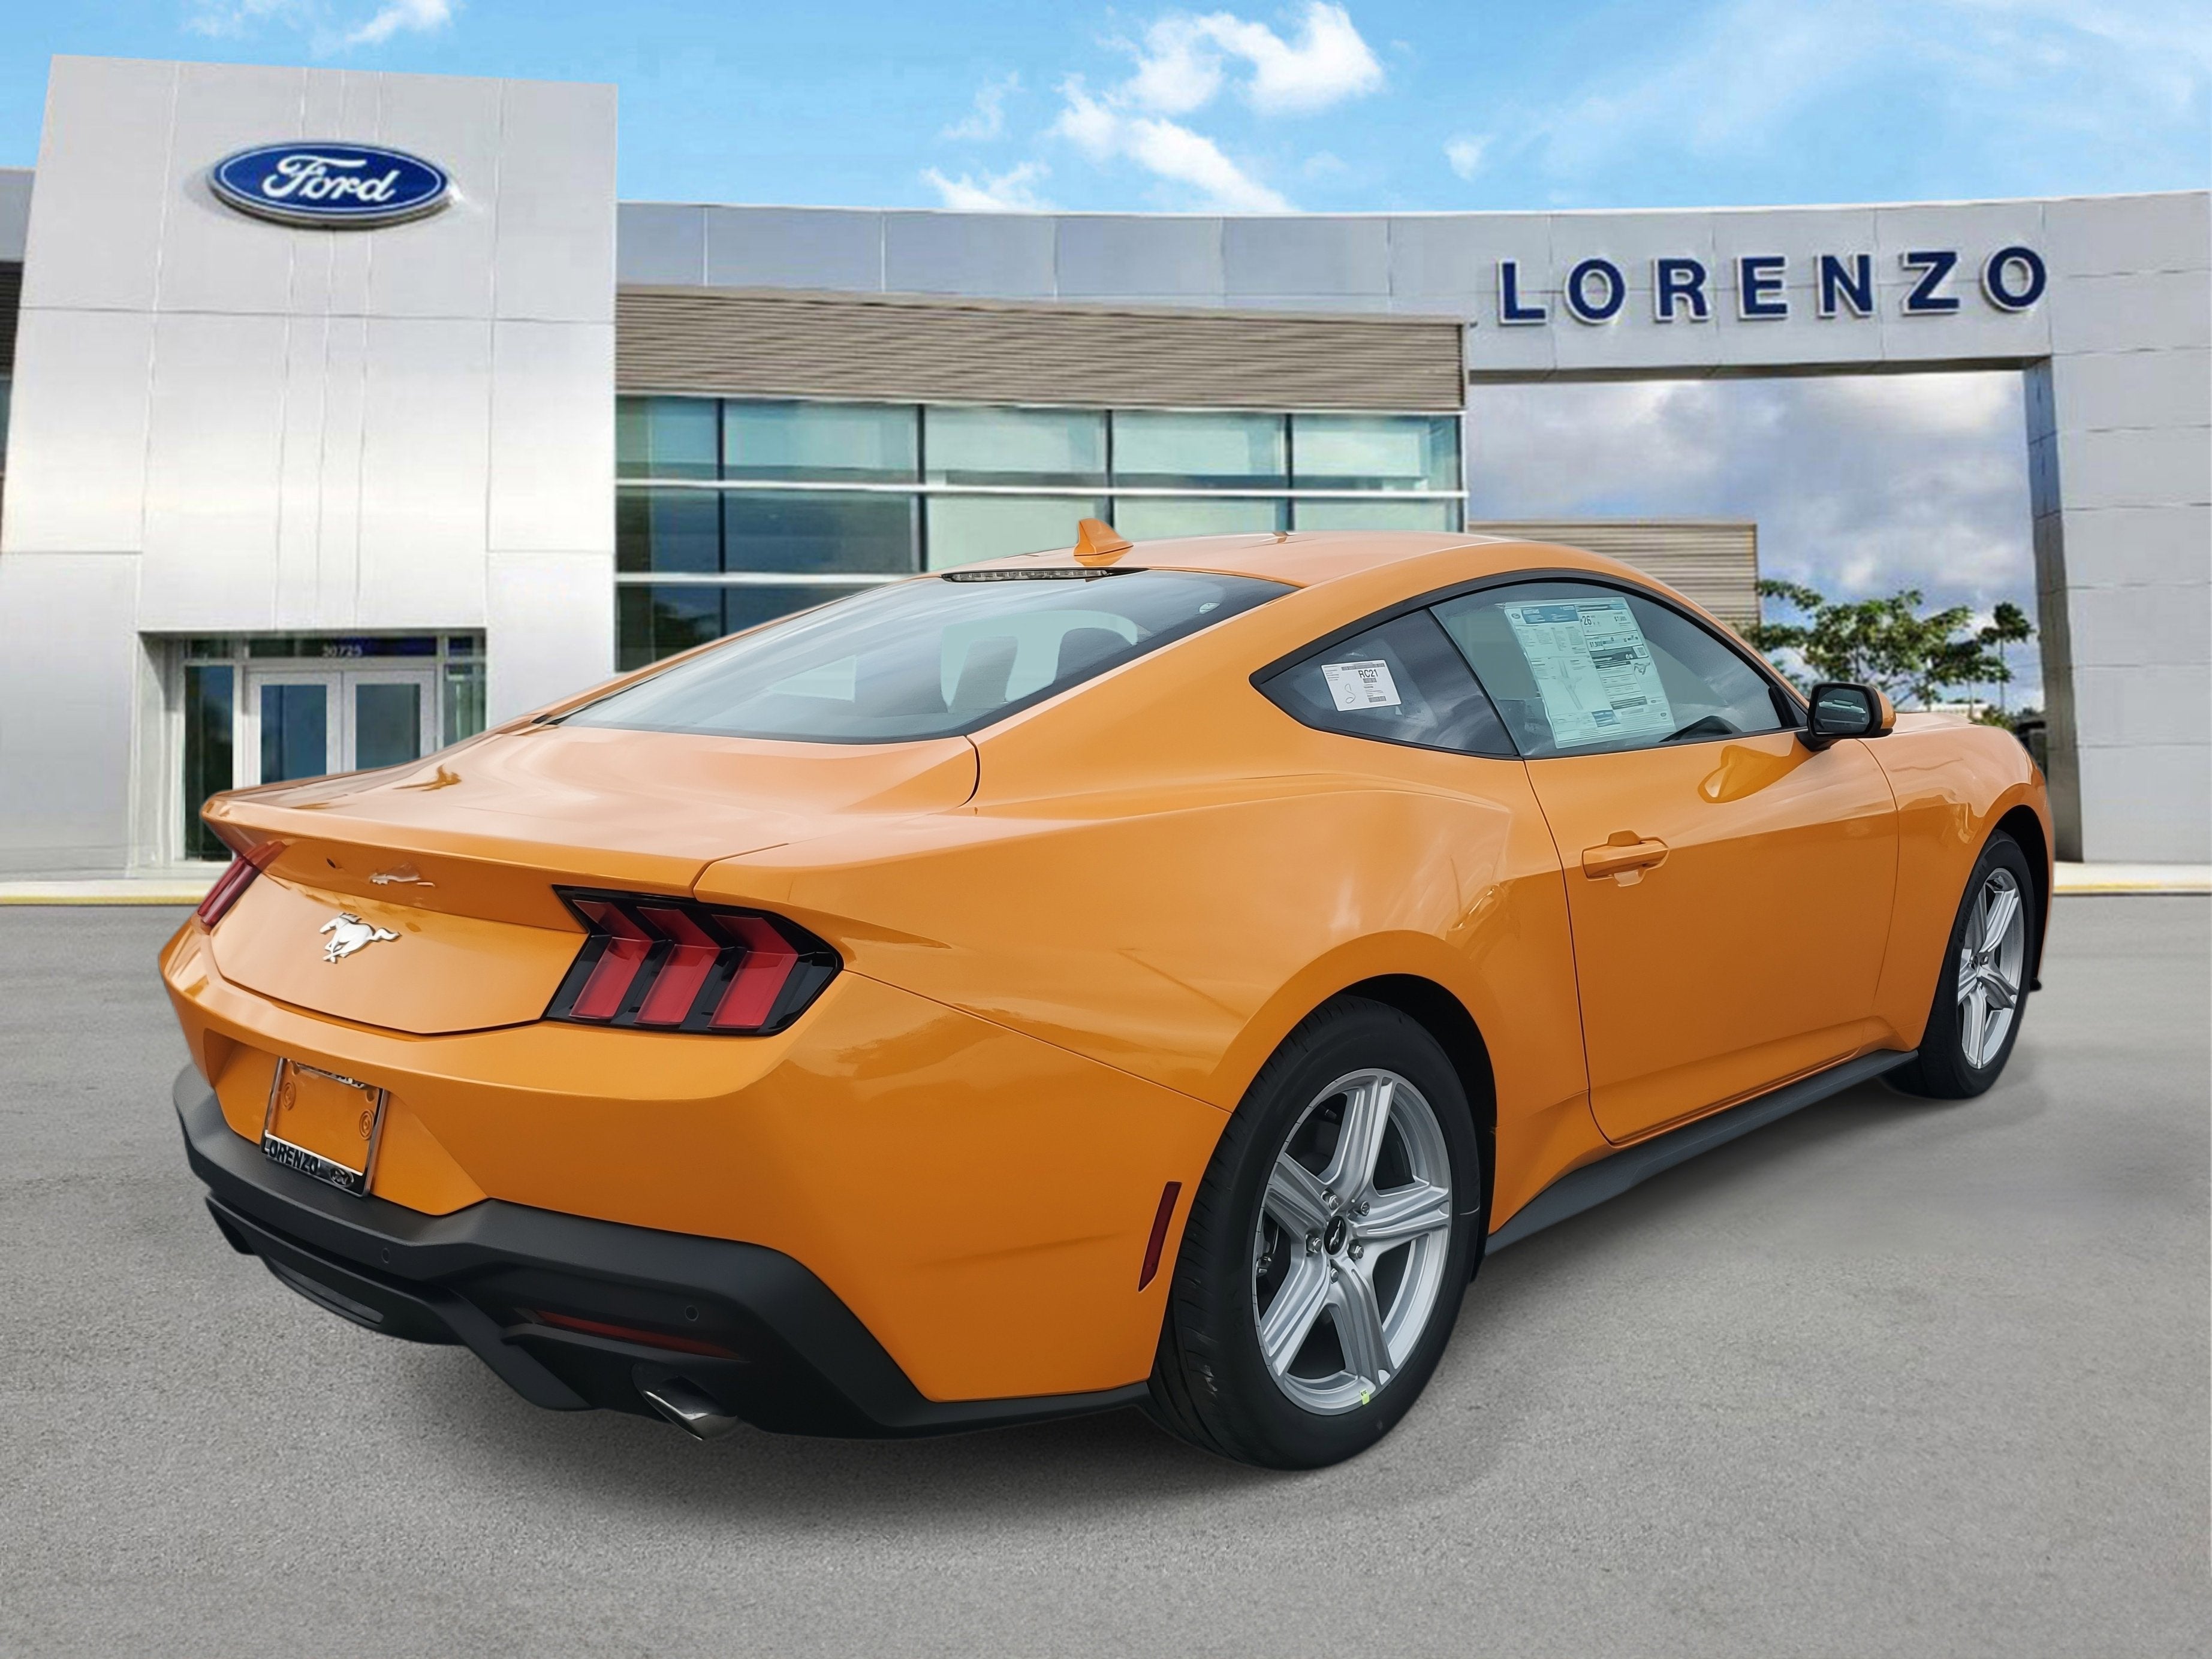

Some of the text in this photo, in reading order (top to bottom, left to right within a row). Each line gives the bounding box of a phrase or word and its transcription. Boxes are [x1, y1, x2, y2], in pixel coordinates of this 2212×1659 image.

[262, 155, 400, 202] Ford
[1497, 246, 2047, 325] LORENZO
[1583, 616, 1592, 625] 26
[1358, 669, 1378, 678] RC21
[262, 1139, 320, 1175] LORENZO
